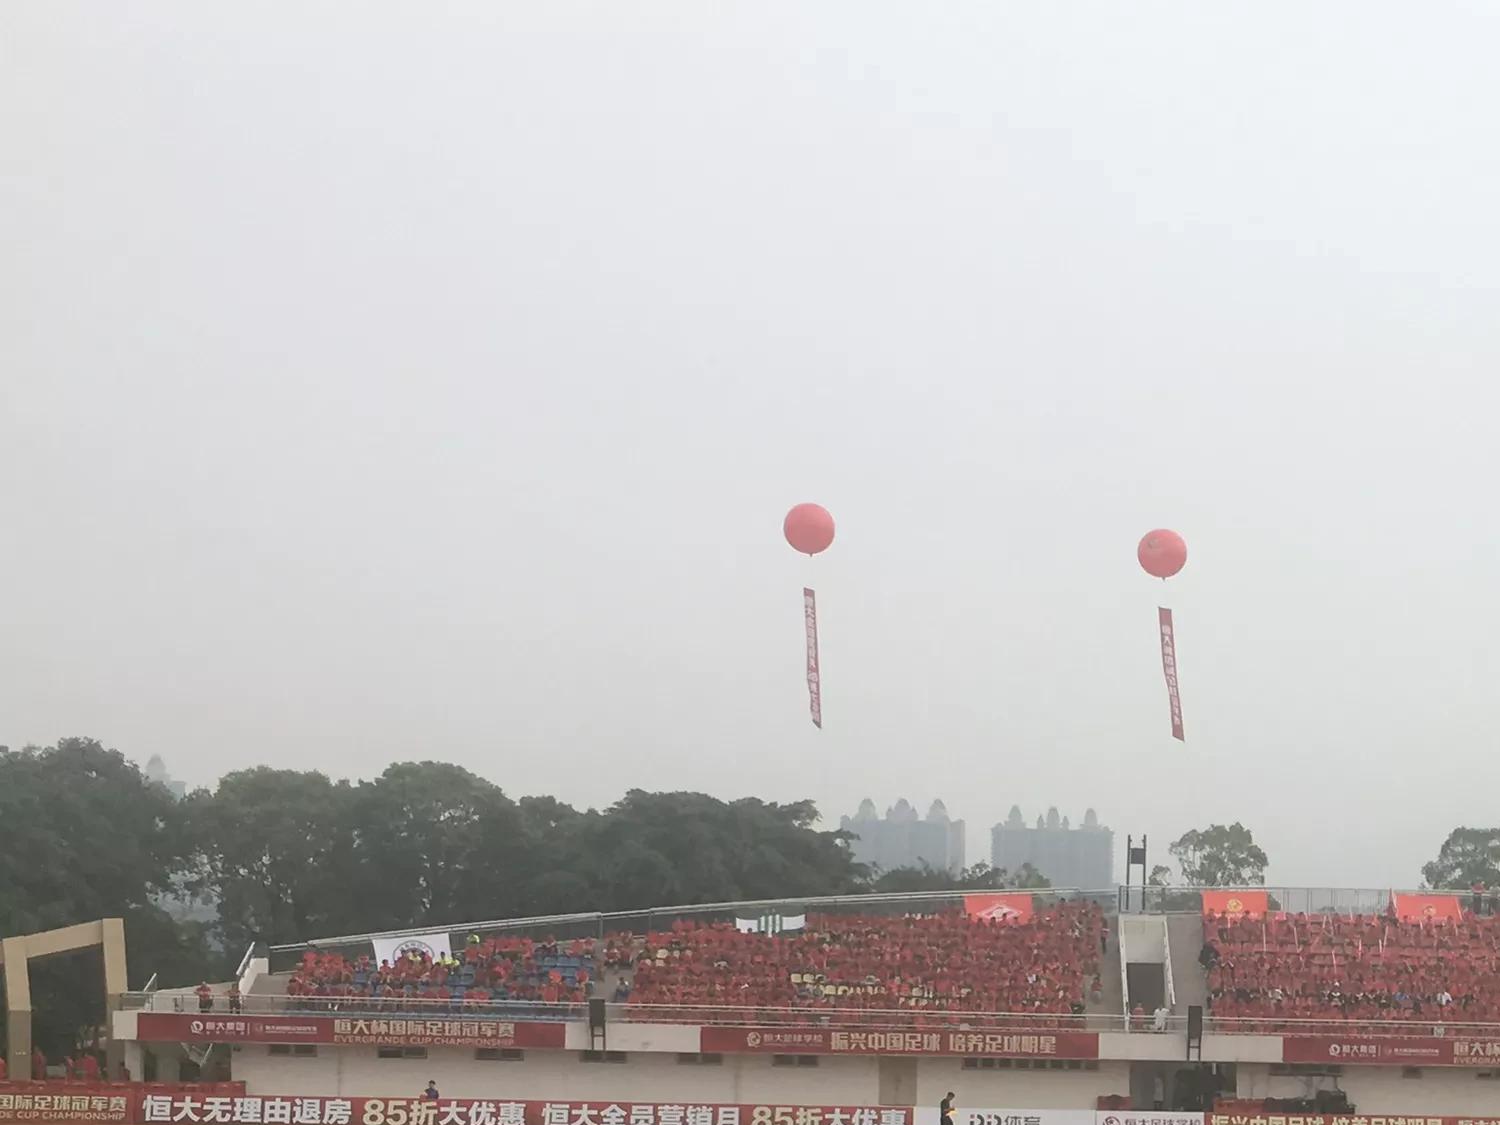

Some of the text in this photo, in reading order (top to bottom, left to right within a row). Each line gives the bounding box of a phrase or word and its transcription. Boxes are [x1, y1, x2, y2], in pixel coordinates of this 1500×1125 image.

[334, 1019, 515, 1037] 恒大杯国际足球冠军赛
[831, 1032, 1056, 1053] 振兴中国足球 培养足球明星
[17, 1111, 39, 1119] CUP
[42, 1111, 125, 1120] CHAMPIONSHIP
[143, 1095, 350, 1125] 恒大无理由退房
